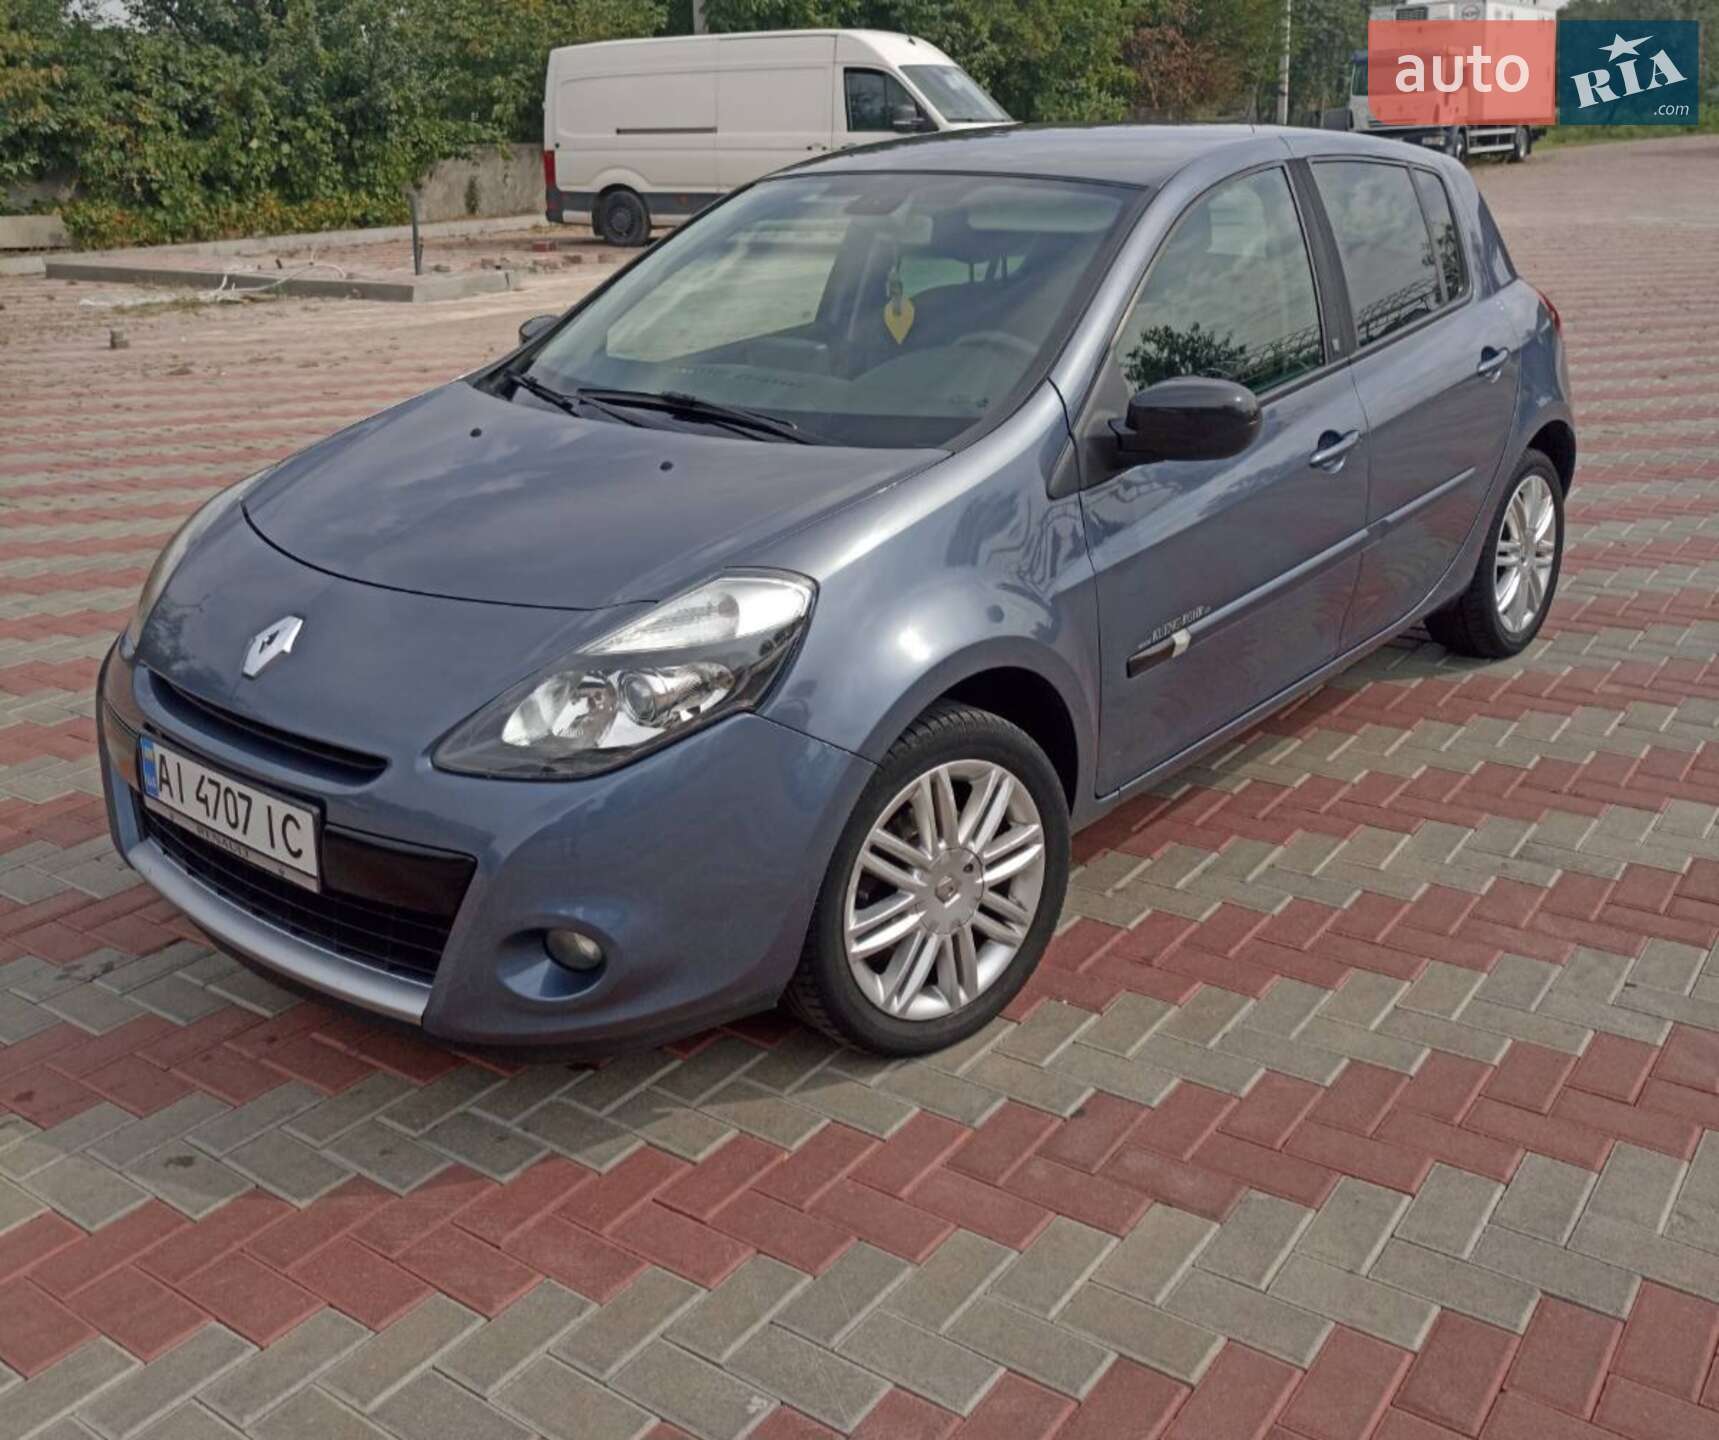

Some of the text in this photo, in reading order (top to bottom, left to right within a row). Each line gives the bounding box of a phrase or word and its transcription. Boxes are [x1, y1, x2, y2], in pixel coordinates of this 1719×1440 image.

[159, 754, 184, 803] AI
[196, 774, 252, 836] 4707
[267, 805, 303, 859] IC
